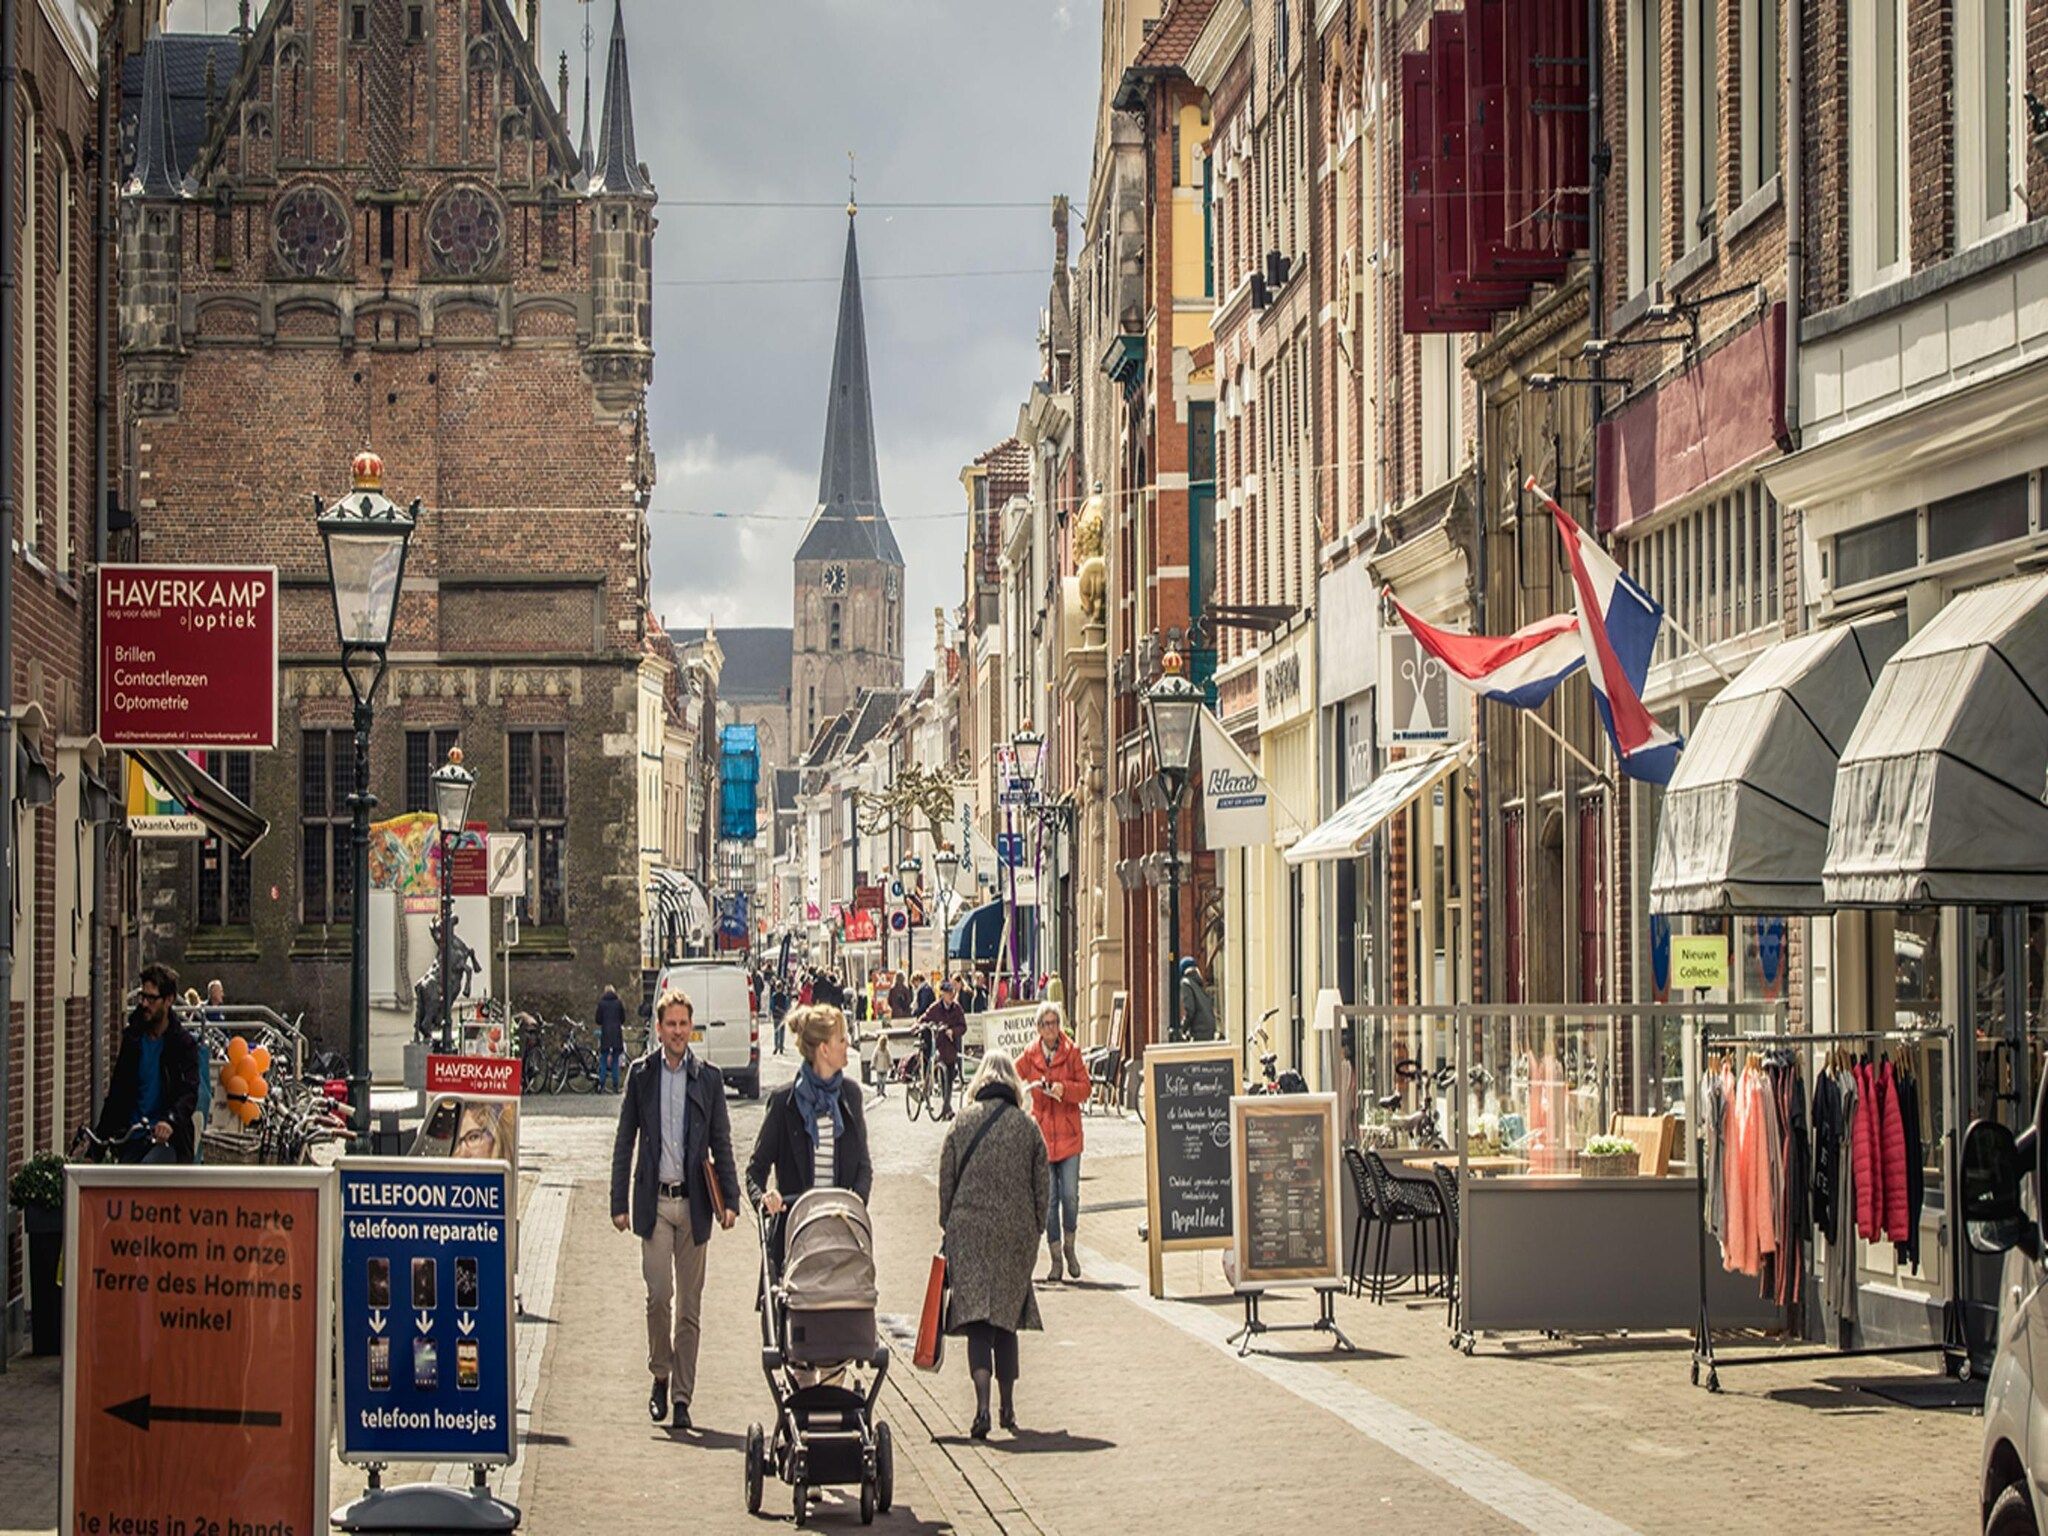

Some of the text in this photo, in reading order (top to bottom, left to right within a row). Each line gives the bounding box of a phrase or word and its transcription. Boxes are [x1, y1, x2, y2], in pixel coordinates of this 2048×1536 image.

[106, 579, 266, 608] HAVERKAMP
[115, 645, 156, 663] Brillen
[114, 669, 208, 687] Contactlenzen
[114, 692, 189, 713] Optometrie
[131, 818, 198, 832] VakantieXperts
[1681, 949, 1717, 961] Nieuwe
[1680, 966, 1719, 979] Collectie
[1004, 1016, 1037, 1031] NIEUW
[998, 1031, 1037, 1046] COLLEC
[435, 1062, 513, 1080] HAVERKAMP
[348, 1183, 499, 1209] TELEFOON ZONE
[106, 1199, 294, 1231] U bent van harte
[349, 1217, 499, 1246] telefoon reparatie
[111, 1236, 286, 1265] welkom in onze
[92, 1268, 302, 1300] Terre des Hommes
[160, 1307, 232, 1332] winkel
[360, 1407, 497, 1434] telefoon hoesjes
[79, 1511, 294, 1536] 1e keus in 2e hands
